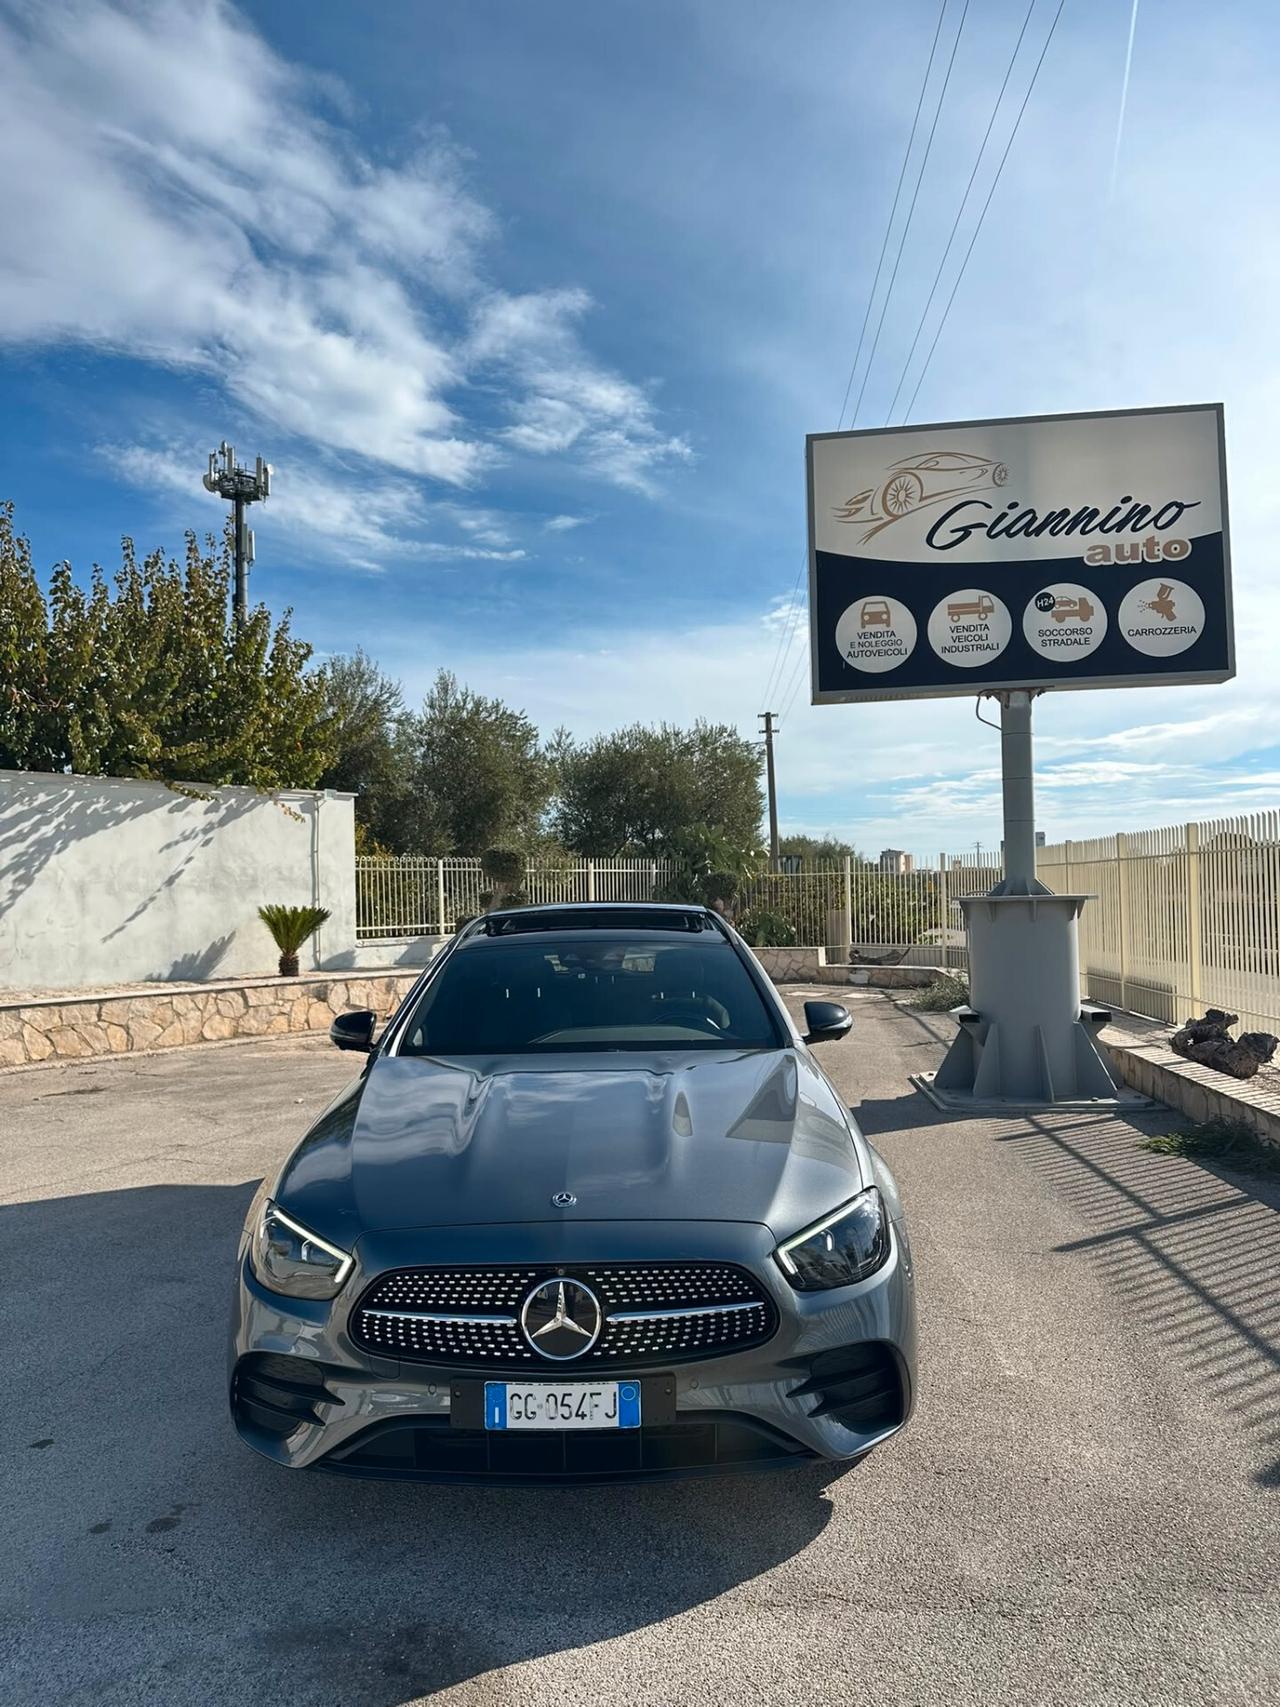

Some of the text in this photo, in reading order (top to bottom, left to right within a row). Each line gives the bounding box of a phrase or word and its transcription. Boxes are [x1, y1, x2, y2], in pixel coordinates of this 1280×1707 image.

[926, 495, 1202, 550] Giannino
[1085, 536, 1190, 564] auto
[1036, 597, 1055, 608] H24
[949, 623, 990, 634] VENDITA
[1038, 627, 1093, 638] SOCCORSO
[1127, 626, 1197, 637] CARROZZERIA
[857, 630, 896, 640] VENDITA
[951, 633, 988, 643] VEICOLI
[850, 638, 903, 649] E NOLEGGIO
[1041, 637, 1090, 647] STRADALE
[847, 647, 908, 659] AUTOVEICOLI
[941, 642, 999, 654] INDUSTRIALI
